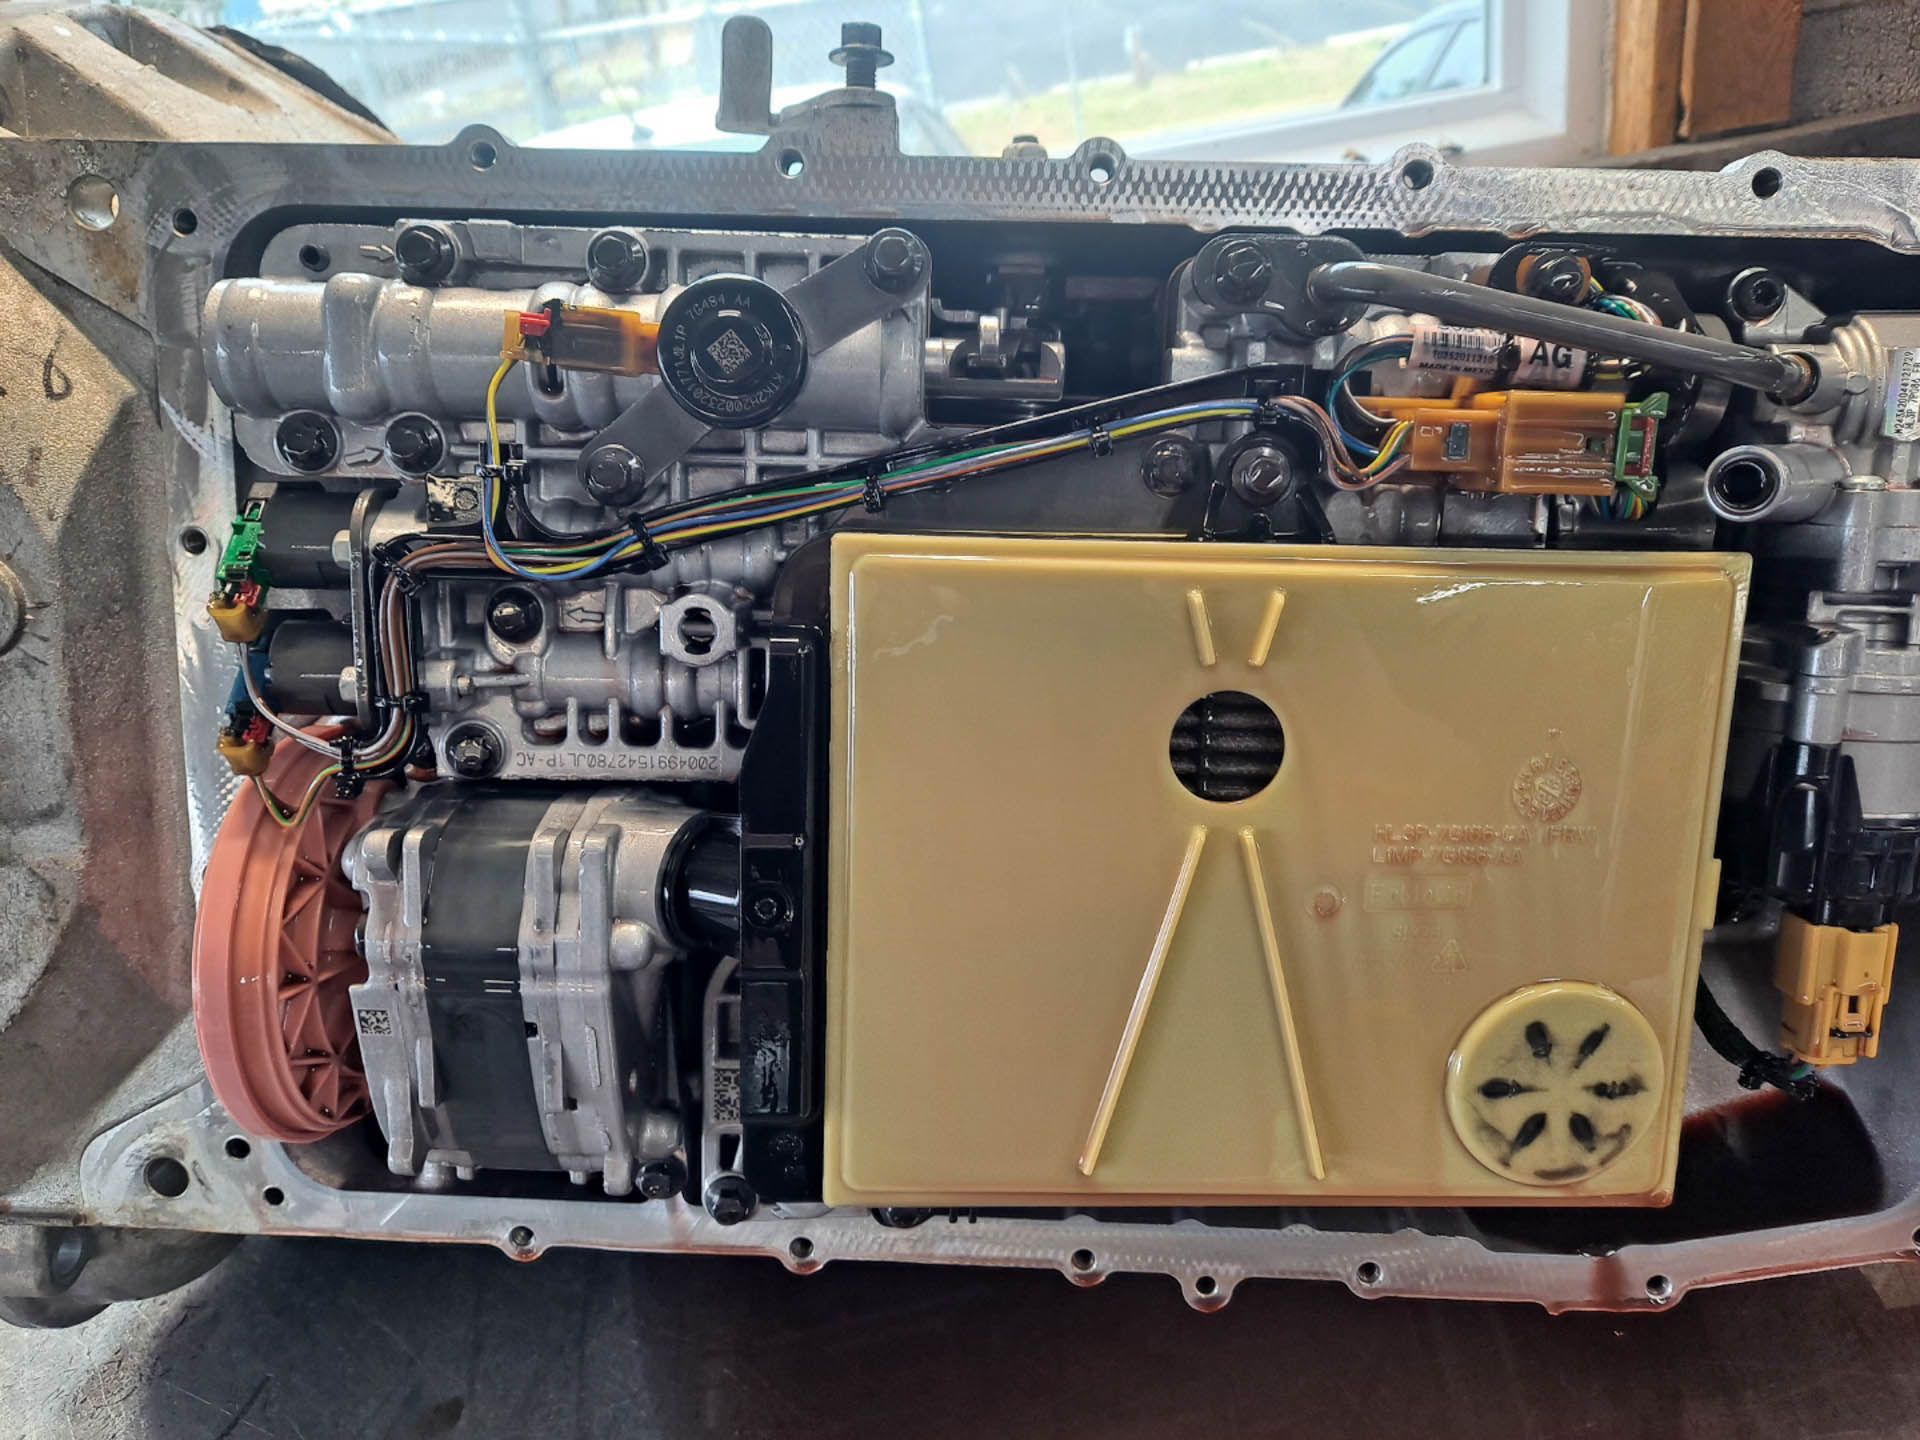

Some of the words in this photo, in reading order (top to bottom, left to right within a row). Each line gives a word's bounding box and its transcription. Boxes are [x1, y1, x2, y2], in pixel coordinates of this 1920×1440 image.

[1529, 339, 1573, 369] AG
[1418, 361, 1448, 369] MADE
[1463, 366, 1497, 374] MEXIC
